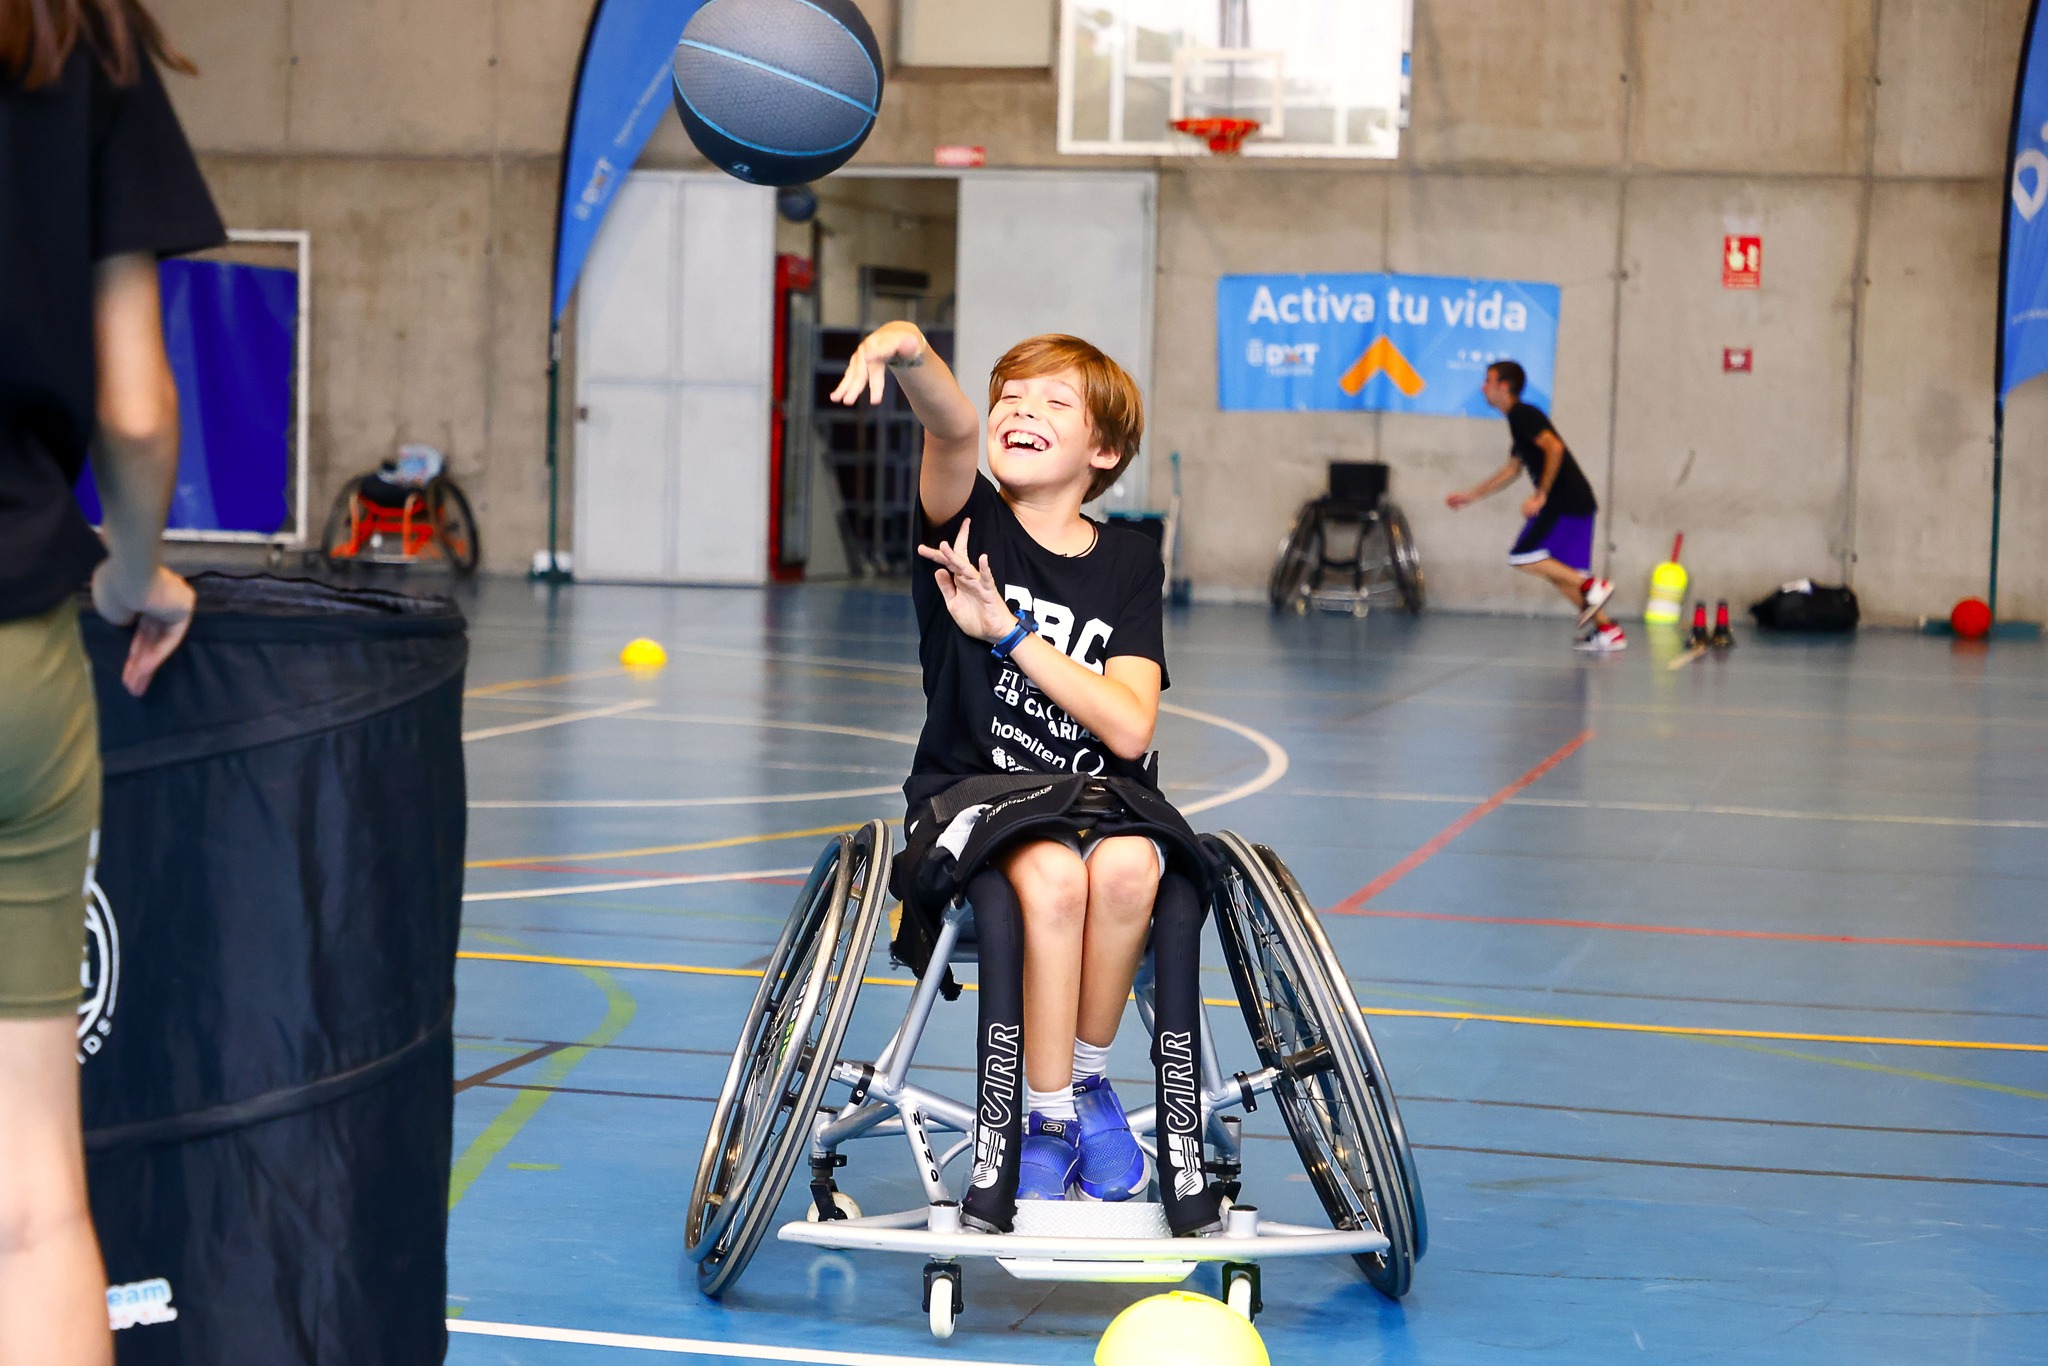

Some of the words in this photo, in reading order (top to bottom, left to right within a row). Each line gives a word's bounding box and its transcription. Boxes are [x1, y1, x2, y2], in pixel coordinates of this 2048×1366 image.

[1248, 284, 1374, 324] Activa
[1388, 287, 1429, 325] tu
[1441, 289, 1527, 332] vida
